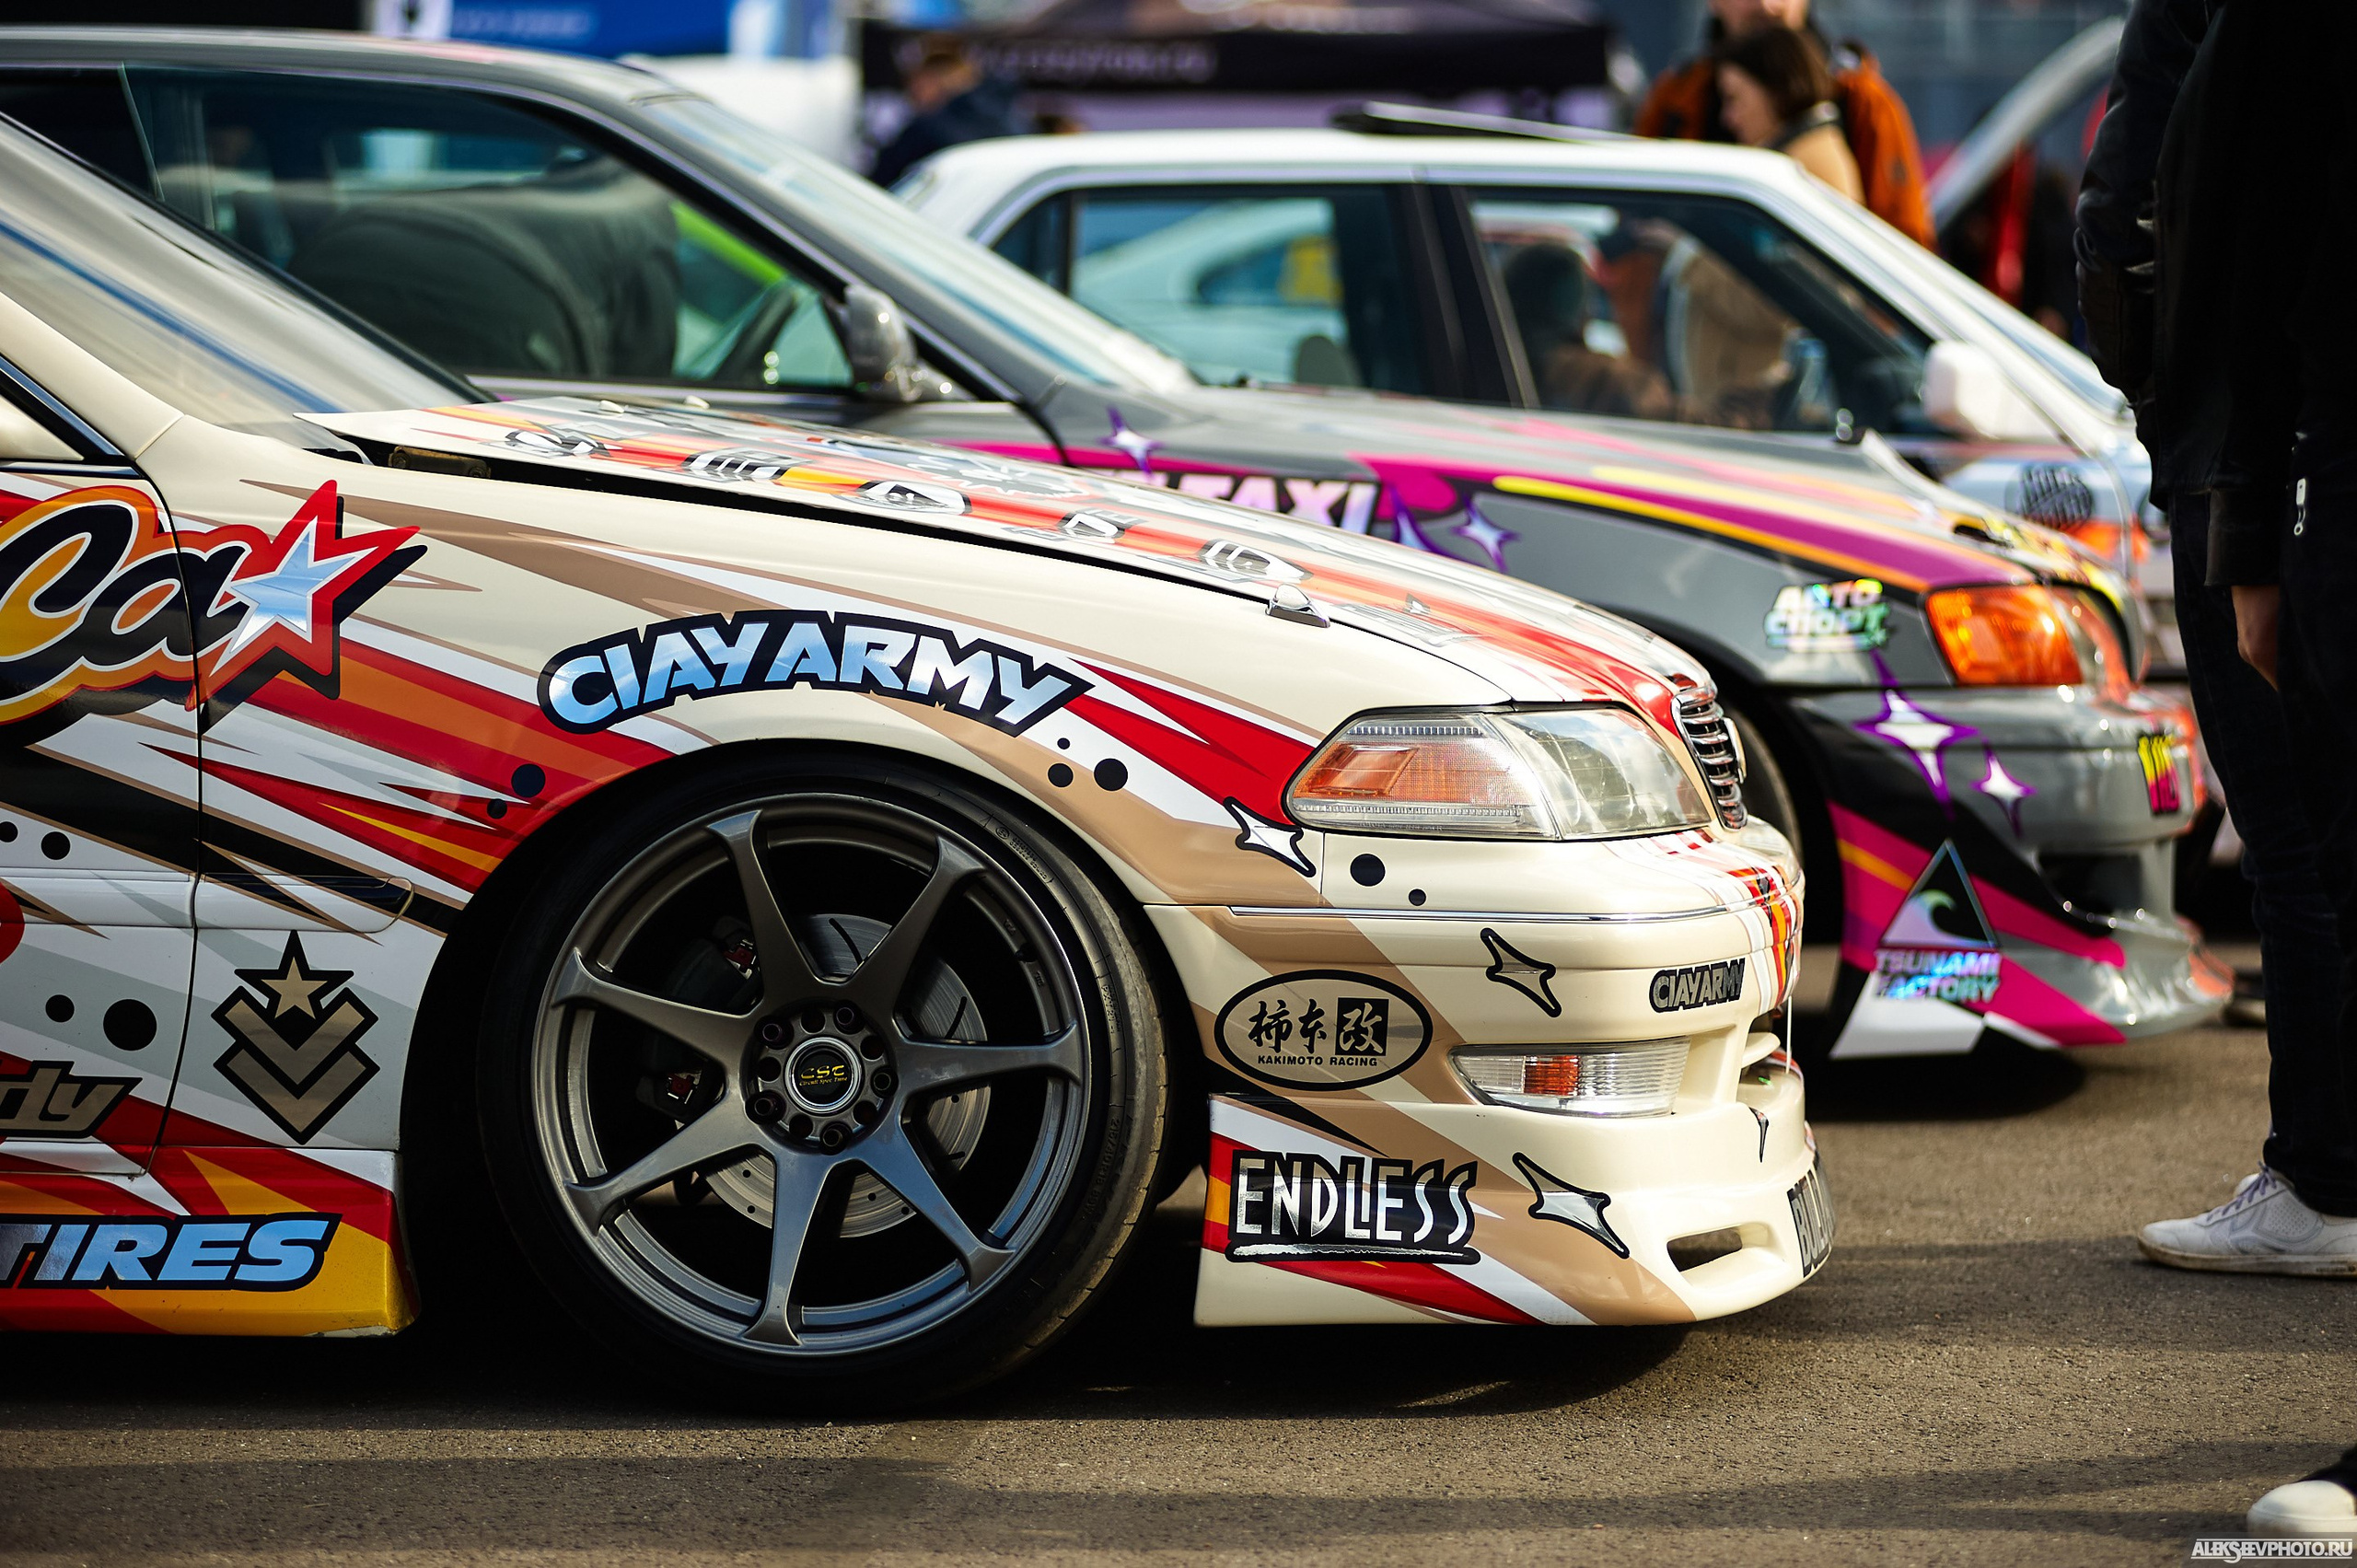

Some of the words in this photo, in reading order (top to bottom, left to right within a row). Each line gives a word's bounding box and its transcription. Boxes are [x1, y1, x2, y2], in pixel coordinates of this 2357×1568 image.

[766, 621, 1072, 726] ARMY
[1875, 950, 2001, 978] TSUNAMI
[1875, 974, 2000, 1004] FACTORY
[1258, 1055, 1323, 1065] KAKIMOTO
[1329, 1056, 1377, 1066] RACING
[1236, 1156, 1469, 1245] ENDLESS
